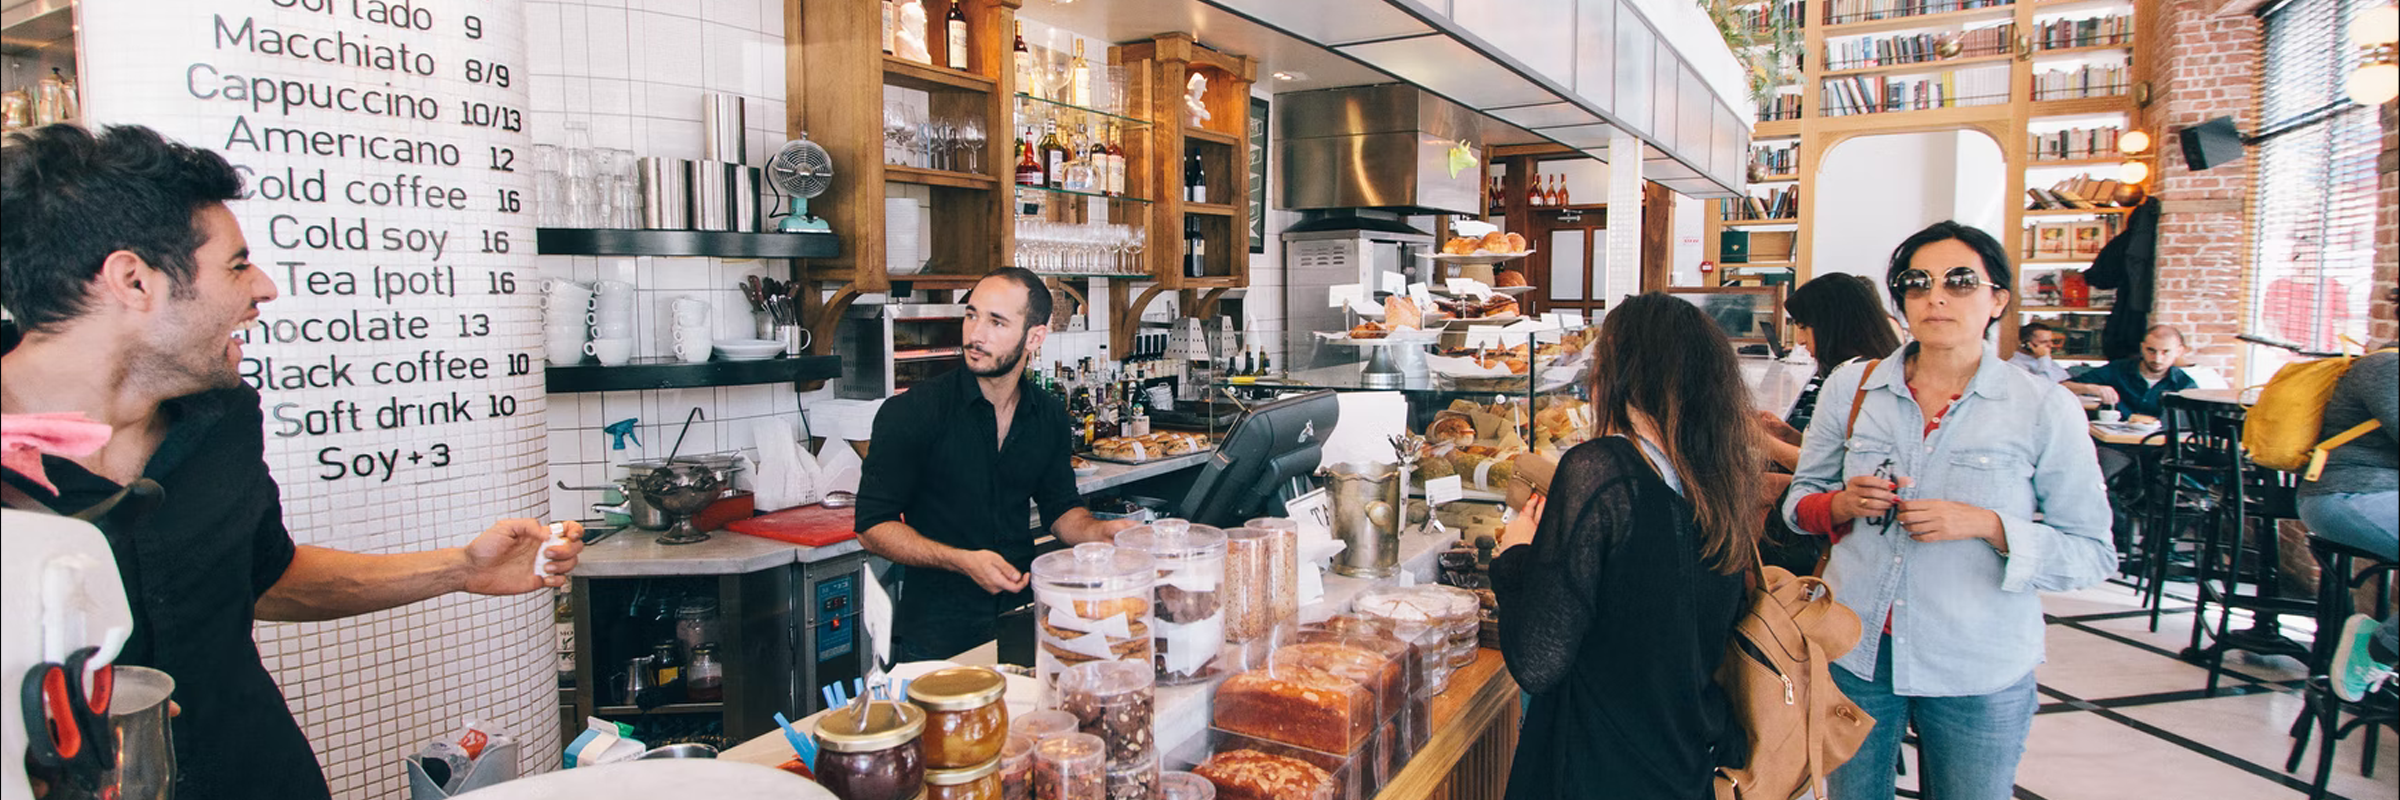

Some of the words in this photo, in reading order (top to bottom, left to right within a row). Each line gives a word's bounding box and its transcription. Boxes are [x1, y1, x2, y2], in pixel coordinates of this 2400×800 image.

[464, 15, 482, 39] 9
[213, 13, 435, 76] Macchiato
[465, 59, 510, 88] 8/9
[186, 62, 438, 121] Cappuccino
[460, 101, 522, 133] 10/13
[225, 115, 460, 167] Americano
[490, 146, 515, 172] 12
[345, 173, 468, 210] coffee
[497, 189, 521, 213] 16
[269, 213, 369, 251] Cold
[382, 226, 449, 262] soy
[481, 229, 510, 254] 16
[276, 261, 357, 297] Tea
[488, 271, 517, 295] 16
[458, 313, 491, 339] 13
[371, 349, 490, 385] coffee
[507, 352, 531, 377] 10
[272, 400, 363, 438] Soft
[375, 391, 473, 430] drink
[488, 394, 517, 418] 10
[318, 446, 400, 483] Soy
